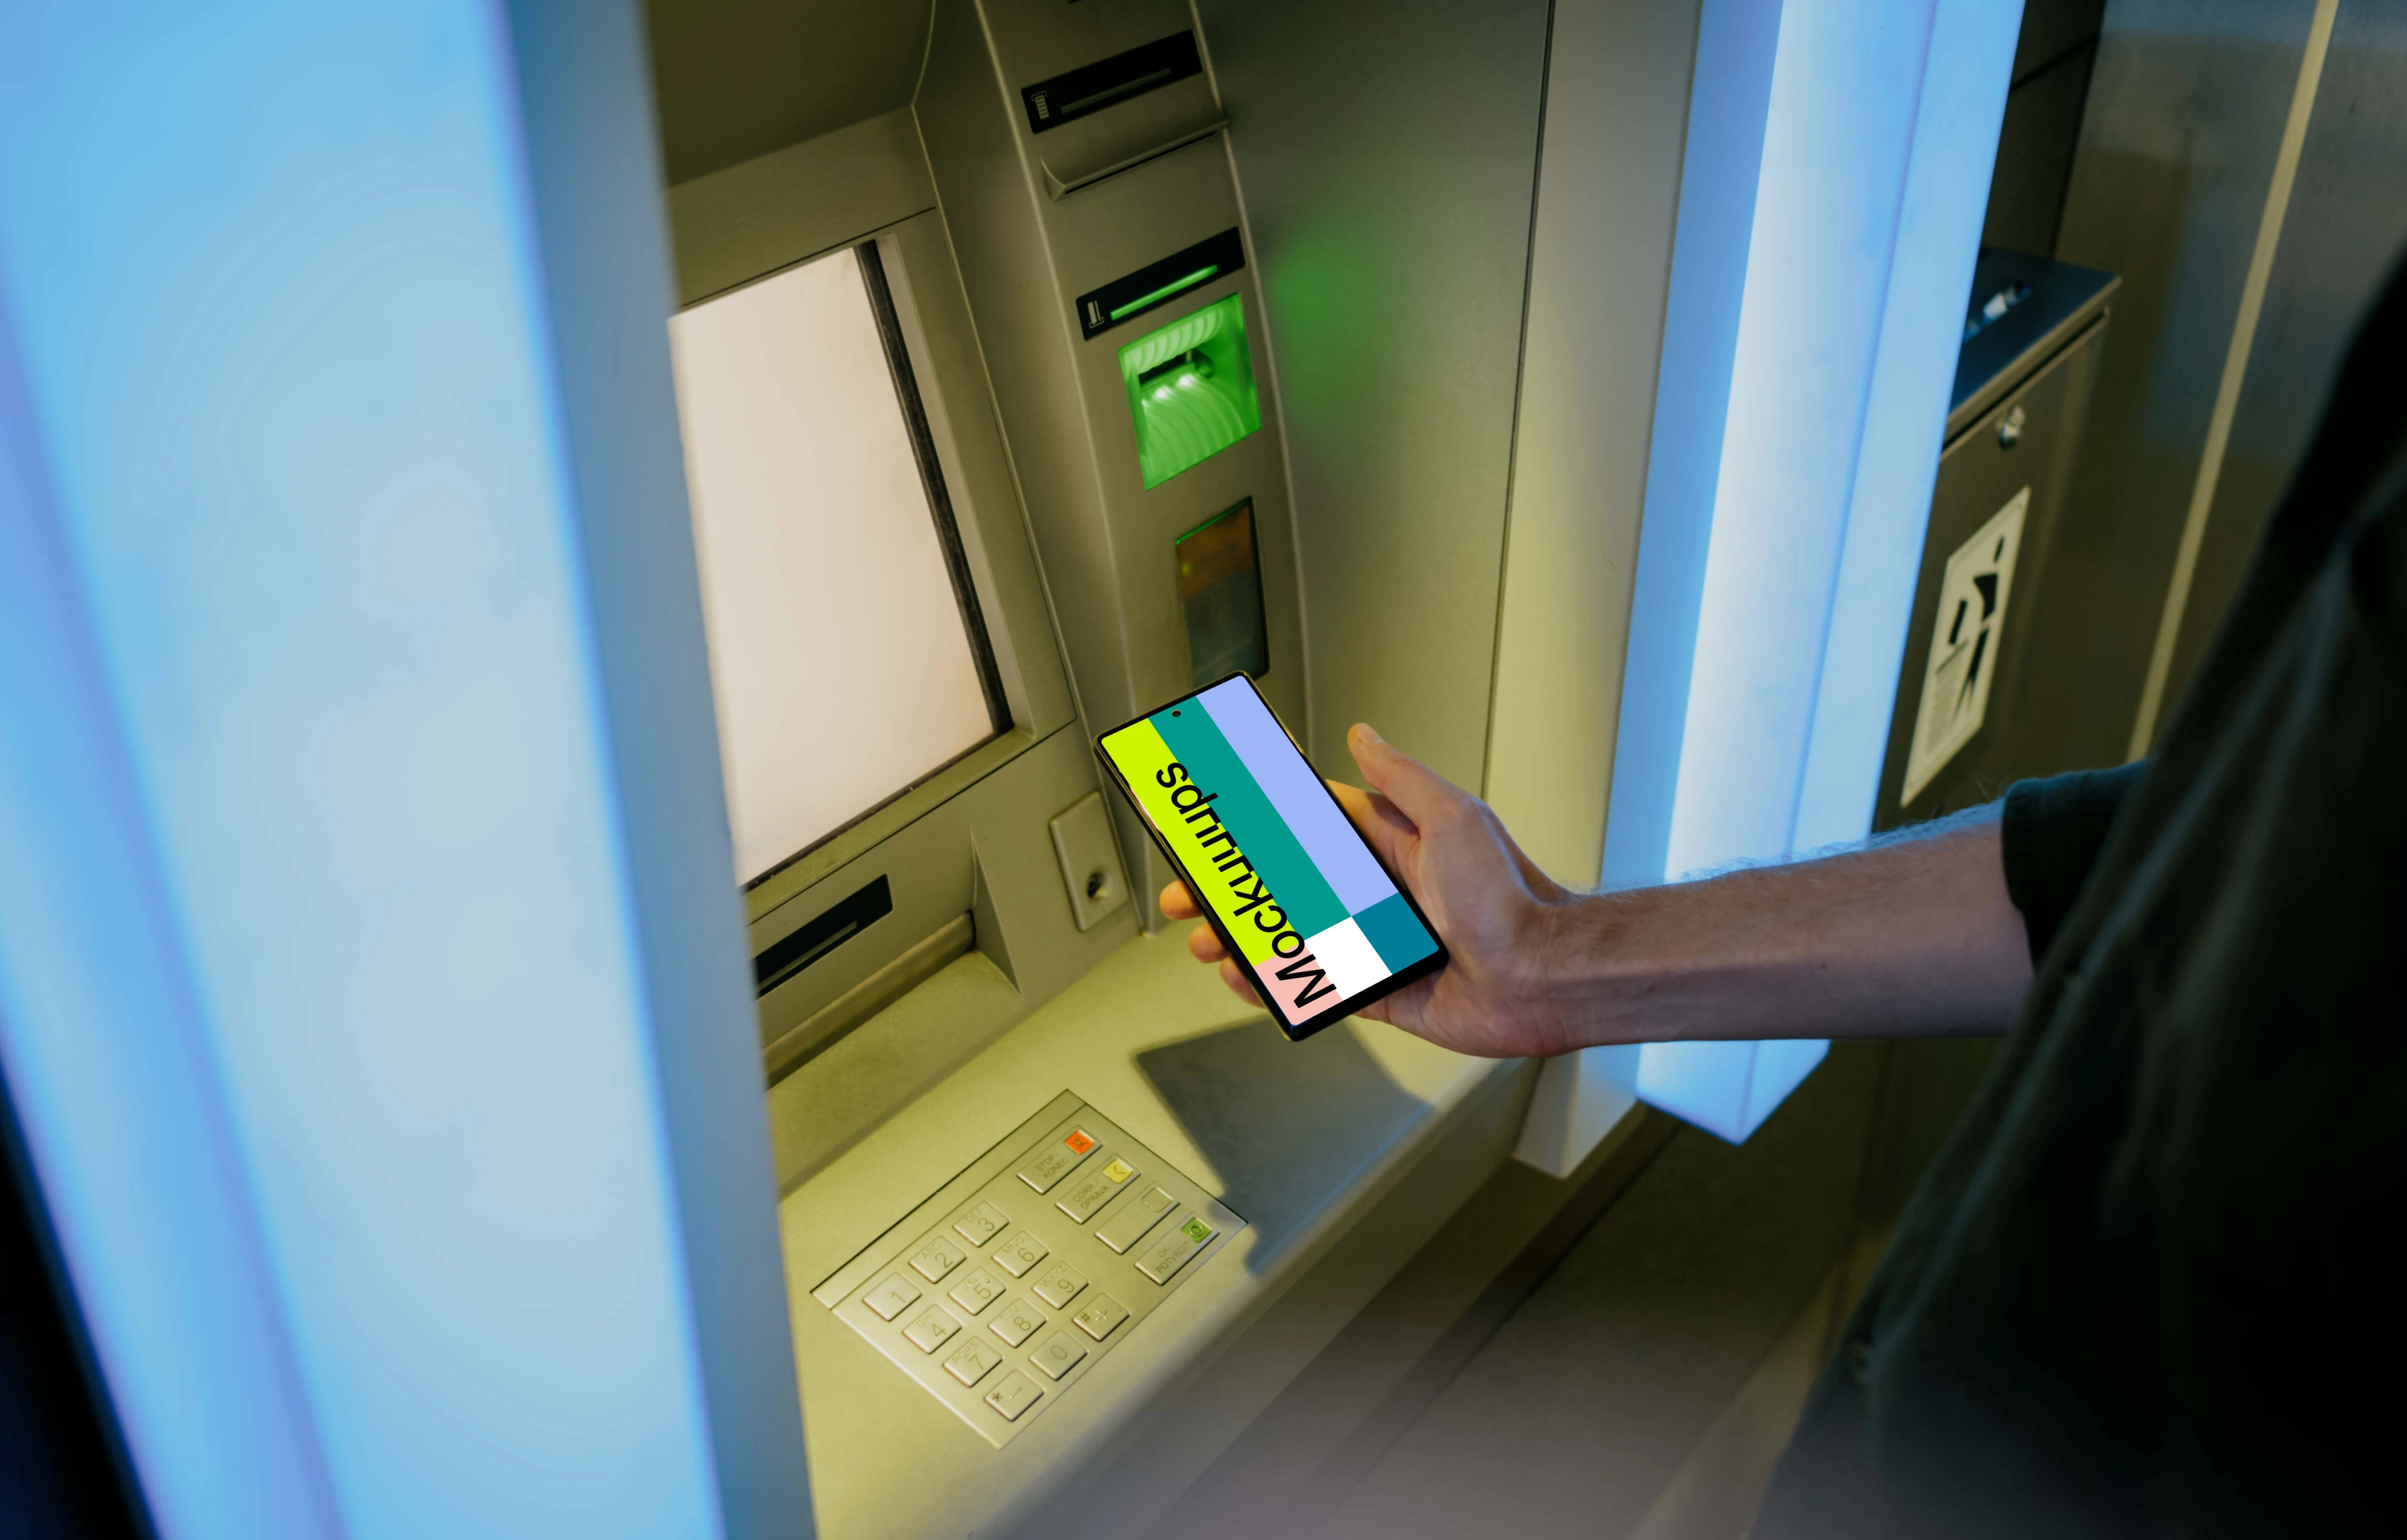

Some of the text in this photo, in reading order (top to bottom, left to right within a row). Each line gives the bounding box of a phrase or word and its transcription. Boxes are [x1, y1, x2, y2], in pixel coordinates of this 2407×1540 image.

[1156, 762, 1337, 1009] Mockuuups
[1035, 1155, 1055, 1172] STOP
[1043, 1157, 1069, 1179] KONEC
[1080, 1185, 1110, 1209] OPRAVA
[965, 1206, 983, 1223] DEF
[977, 1217, 996, 1232] 3
[921, 1242, 941, 1259] ABC
[1003, 1236, 1024, 1254] MNO
[1157, 1246, 1170, 1258] OK
[934, 1252, 954, 1269] 2
[1018, 1248, 1035, 1262] 6
[1040, 1265, 1068, 1287] WXYZ
[974, 1283, 991, 1299] 5
[1058, 1279, 1074, 1293] 9
[891, 1291, 906, 1304] 1
[917, 1311, 935, 1327] GHI
[999, 1304, 1019, 1322] TUV
[932, 1322, 947, 1337] 4
[1014, 1316, 1032, 1332] 8
[1050, 1345, 1068, 1360] 0
[968, 1353, 985, 1371] 7
